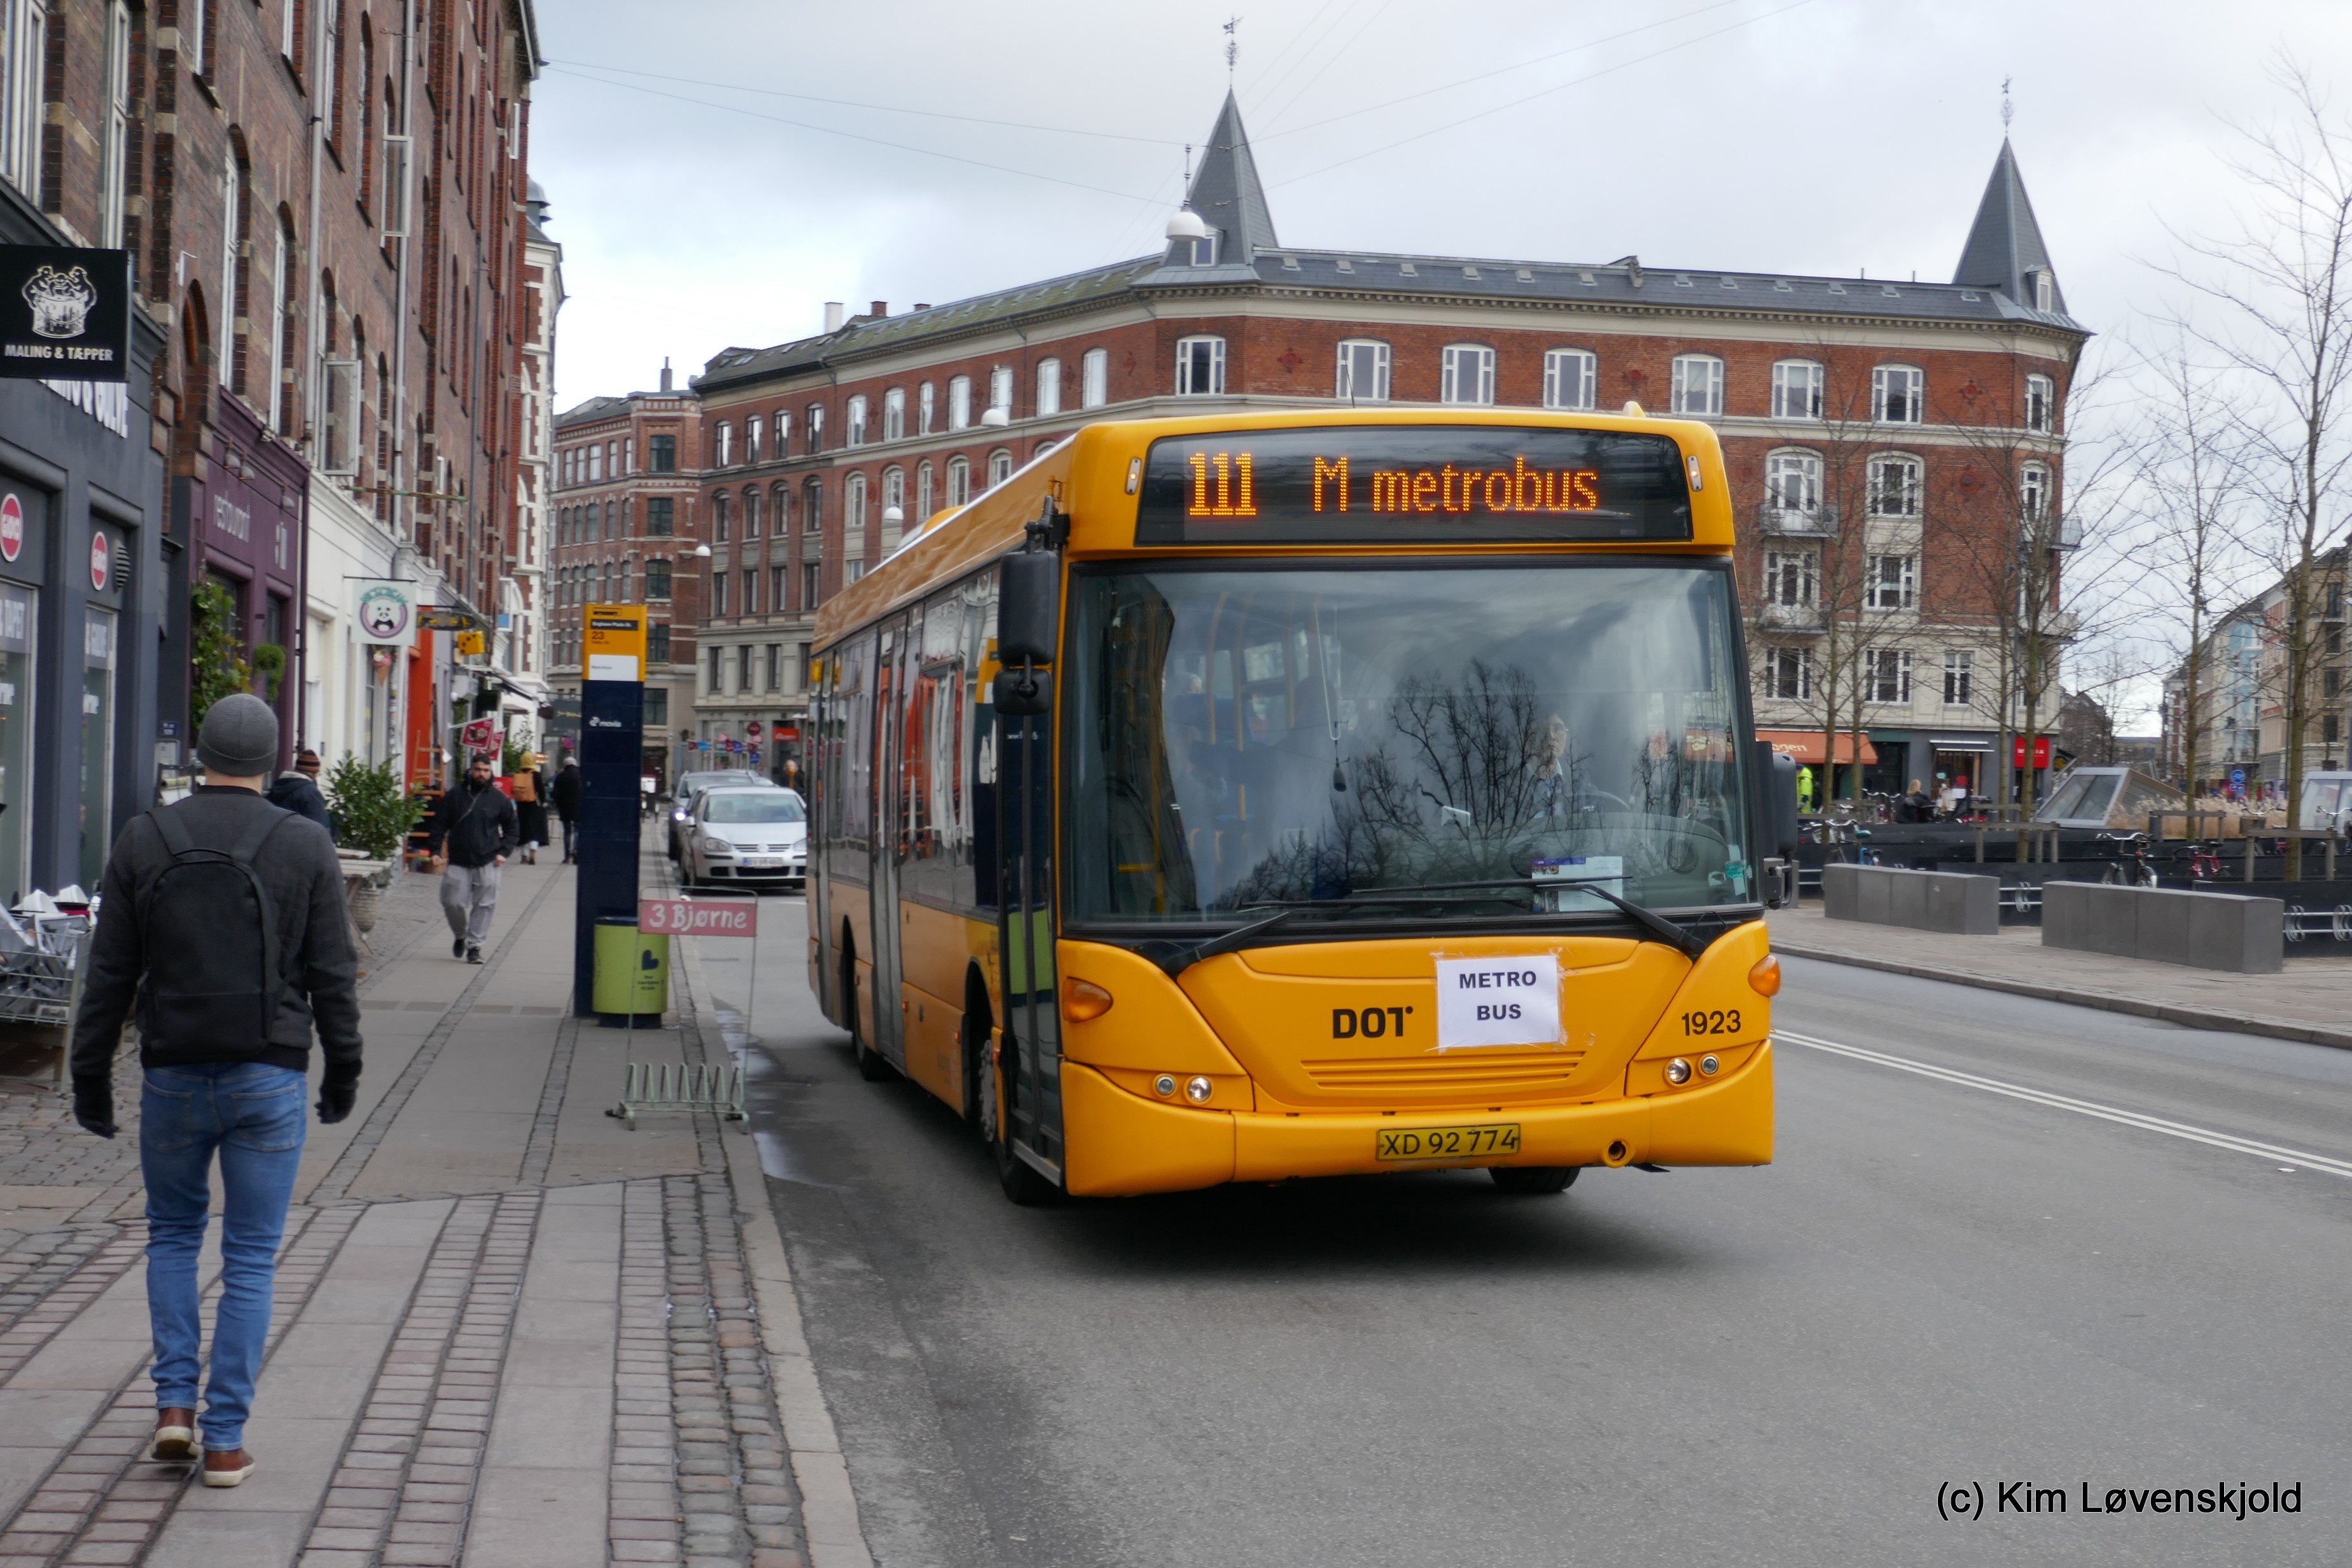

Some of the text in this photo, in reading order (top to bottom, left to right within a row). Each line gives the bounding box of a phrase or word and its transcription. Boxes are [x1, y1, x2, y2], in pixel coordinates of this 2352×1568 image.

[4, 344, 113, 361] MALING & TÆPPER
[1189, 452, 1598, 516] 111 M metrobus
[592, 631, 604, 640] 23
[649, 903, 748, 932] 3 Bjørne
[1459, 971, 1536, 989] METRO
[1332, 1006, 1413, 1039] DOT
[1476, 1004, 1522, 1021] BUS
[1681, 1009, 1742, 1036] 1923
[1384, 1129, 1515, 1156] XD 92 774
